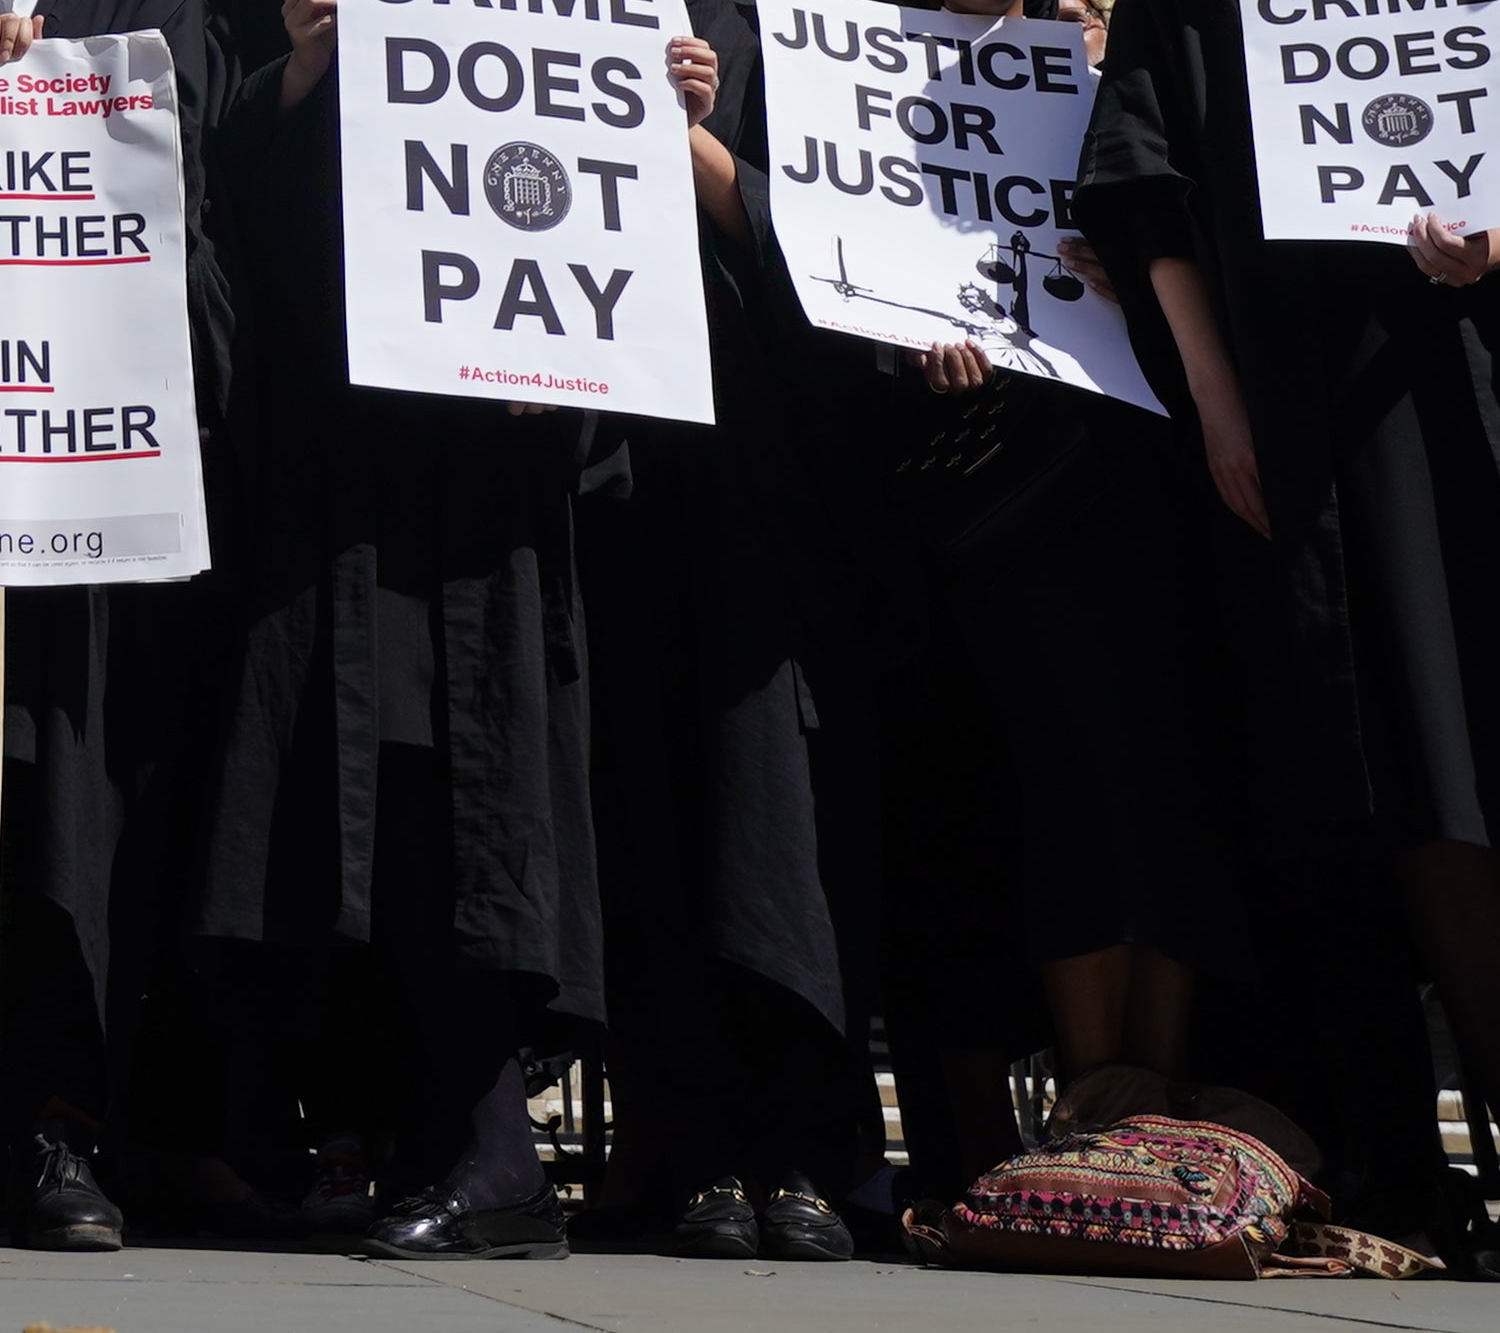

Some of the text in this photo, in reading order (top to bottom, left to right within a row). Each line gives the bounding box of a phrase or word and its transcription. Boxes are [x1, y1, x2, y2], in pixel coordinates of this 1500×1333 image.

[384, 36, 646, 129] DOES
[771, 7, 1080, 95] JUSTICE
[1279, 25, 1492, 85] DOES
[16, 73, 111, 97] Society
[45, 92, 153, 120] Lawyers
[853, 83, 1005, 155] FOR
[781, 135, 1077, 231] JUSTICE
[1316, 152, 1487, 208] PAY
[420, 249, 635, 341] PAY
[458, 364, 609, 396] #Action4Justice
